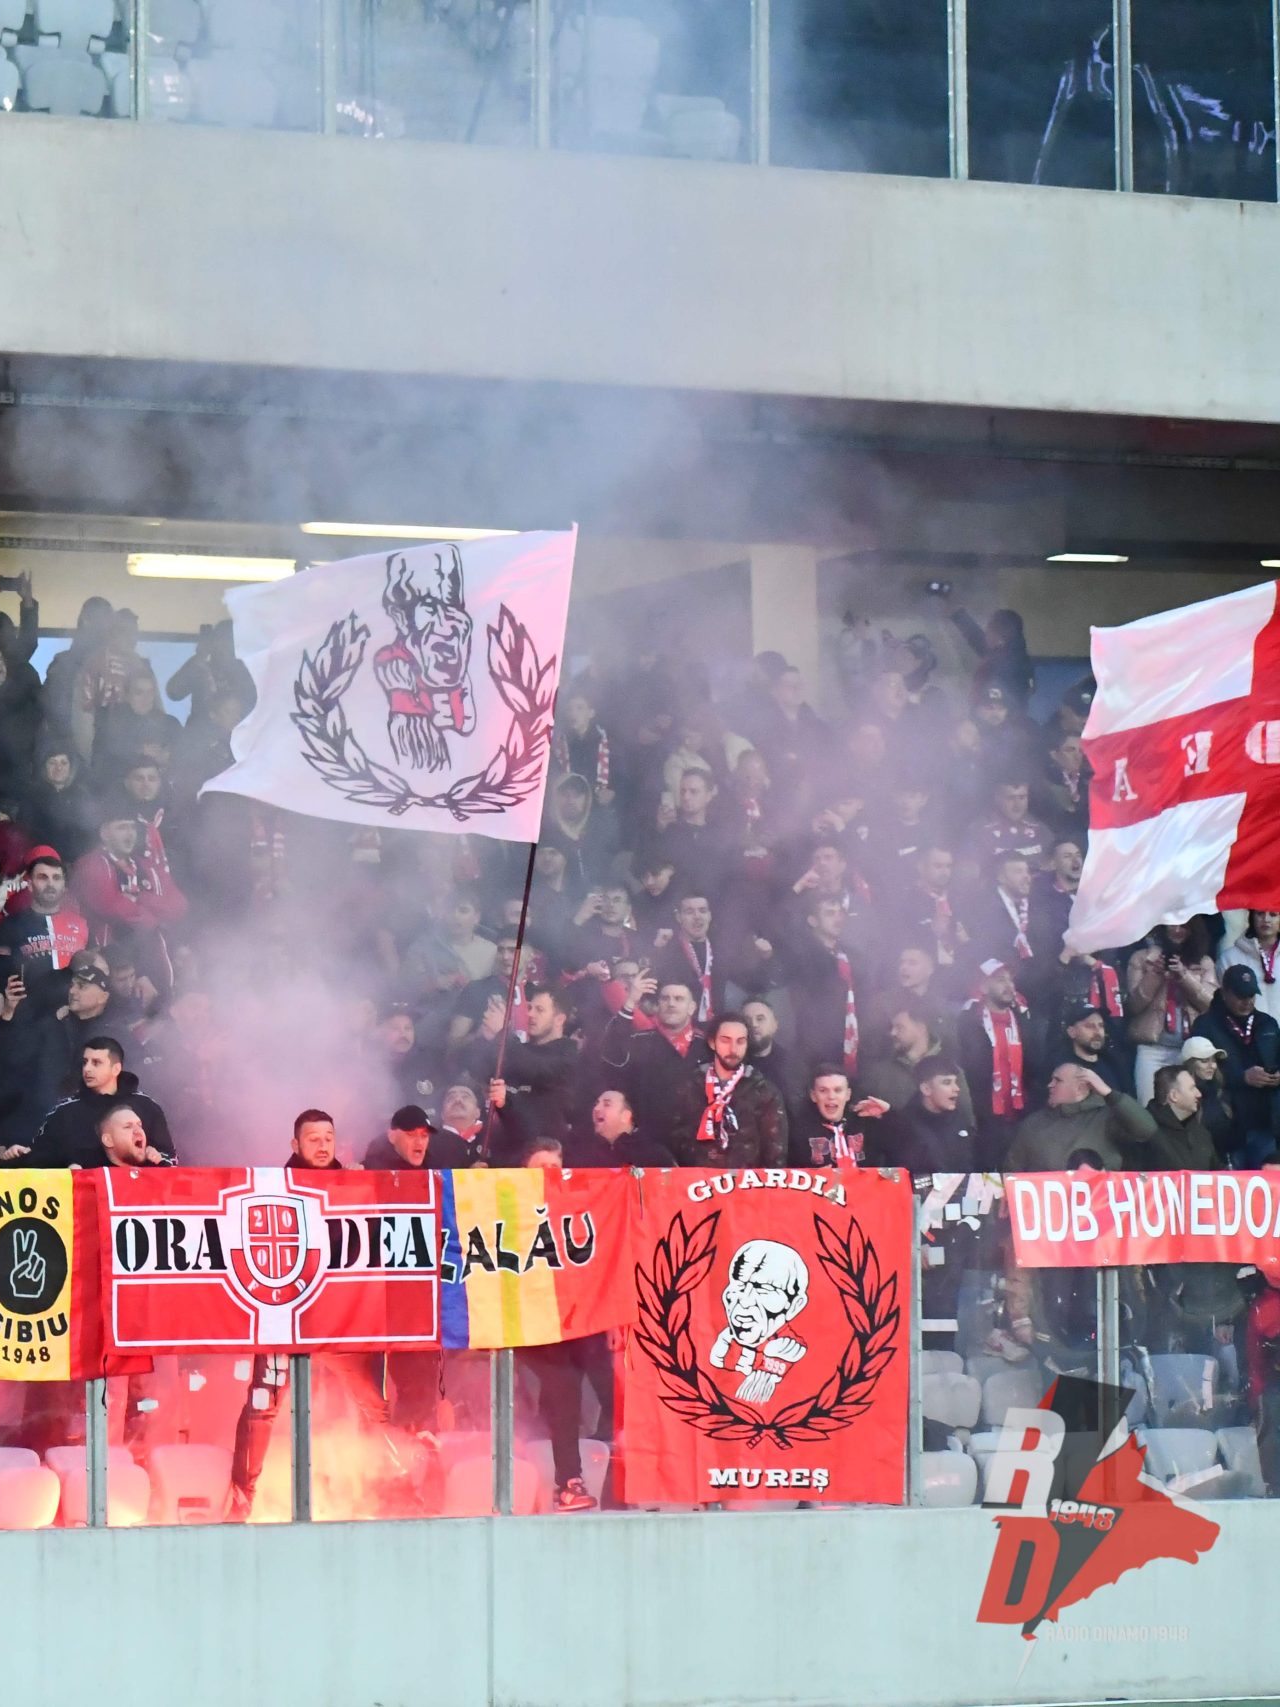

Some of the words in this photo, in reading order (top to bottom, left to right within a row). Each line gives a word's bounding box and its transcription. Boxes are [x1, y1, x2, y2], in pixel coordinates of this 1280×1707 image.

[687, 1168, 847, 1206] GUARDIA
[1014, 1181, 1099, 1242] DDB
[1107, 1174, 1280, 1239] HUNEDO
[1, 1345, 51, 1365] 1948
